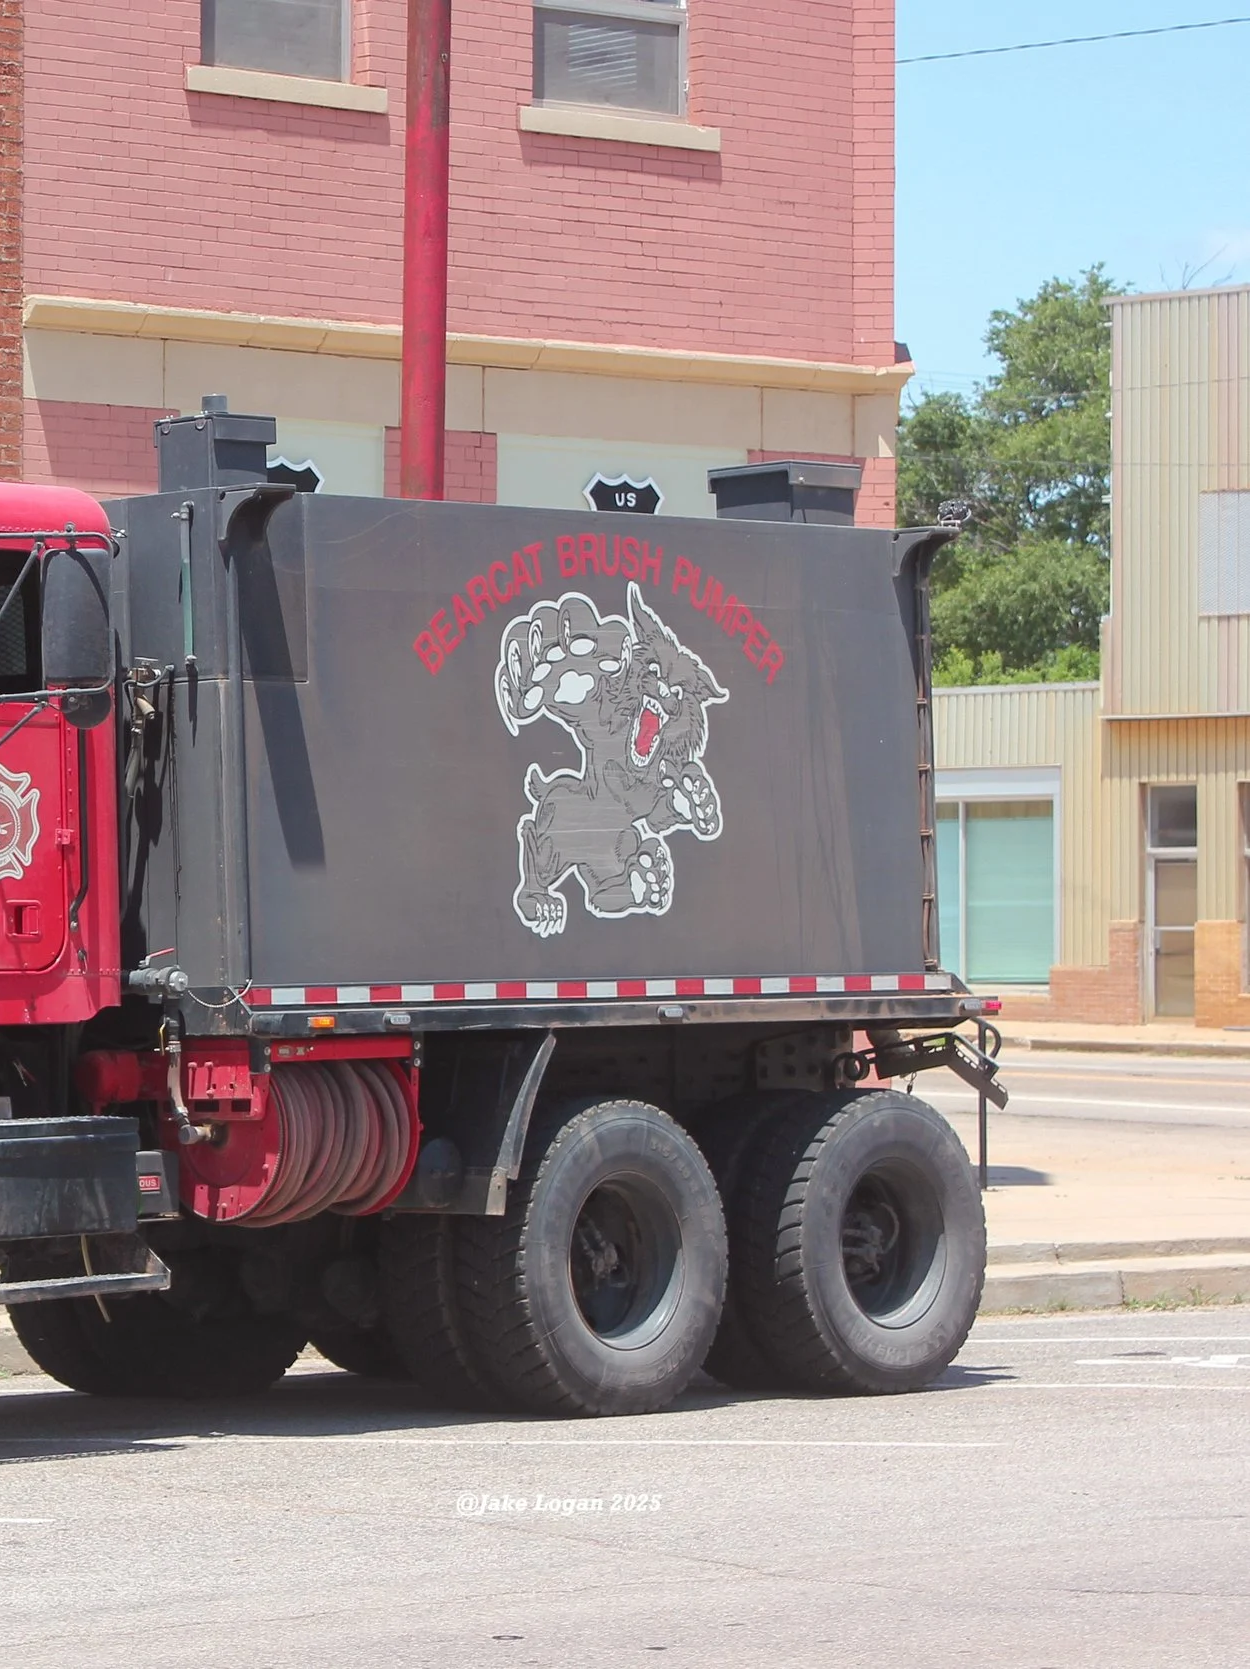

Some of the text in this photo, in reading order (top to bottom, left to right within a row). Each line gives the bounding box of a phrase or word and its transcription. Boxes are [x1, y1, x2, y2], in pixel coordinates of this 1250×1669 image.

[615, 493, 636, 507] US
[413, 533, 784, 686] BEARCAT BRUSH PUMPER
